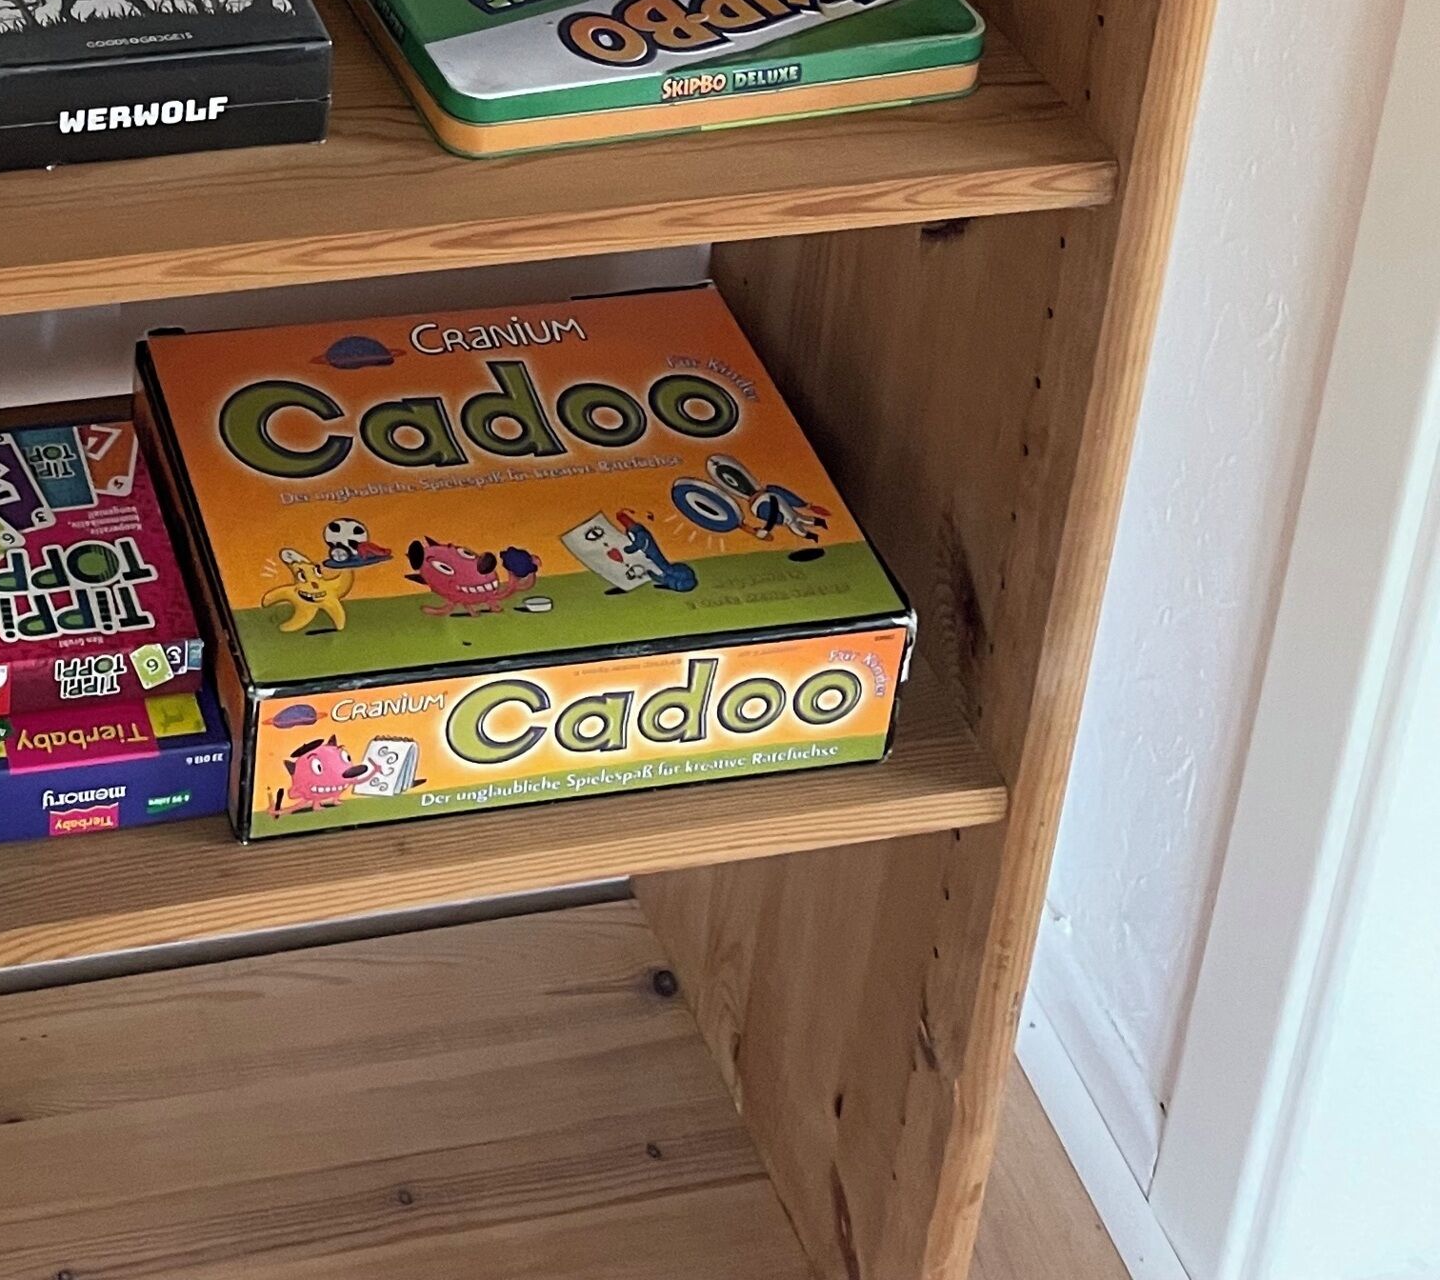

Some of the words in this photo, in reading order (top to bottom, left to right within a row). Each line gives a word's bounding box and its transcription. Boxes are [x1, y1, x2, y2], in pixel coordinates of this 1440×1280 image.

[733, 65, 800, 89] DELUXE
[59, 95, 229, 134] WERWOLF
[217, 359, 742, 481] Cadoo
[315, 481, 416, 504] unglaubliche
[445, 656, 866, 766] Cadoo
[16, 722, 150, 754] Tierbaby
[421, 792, 450, 807] Der
[456, 776, 561, 805] unglaubliche
[566, 764, 654, 790] Spielespaß
[684, 755, 747, 773] kreative
[42, 785, 127, 810] memory
[54, 815, 115, 829] Tierbaby
